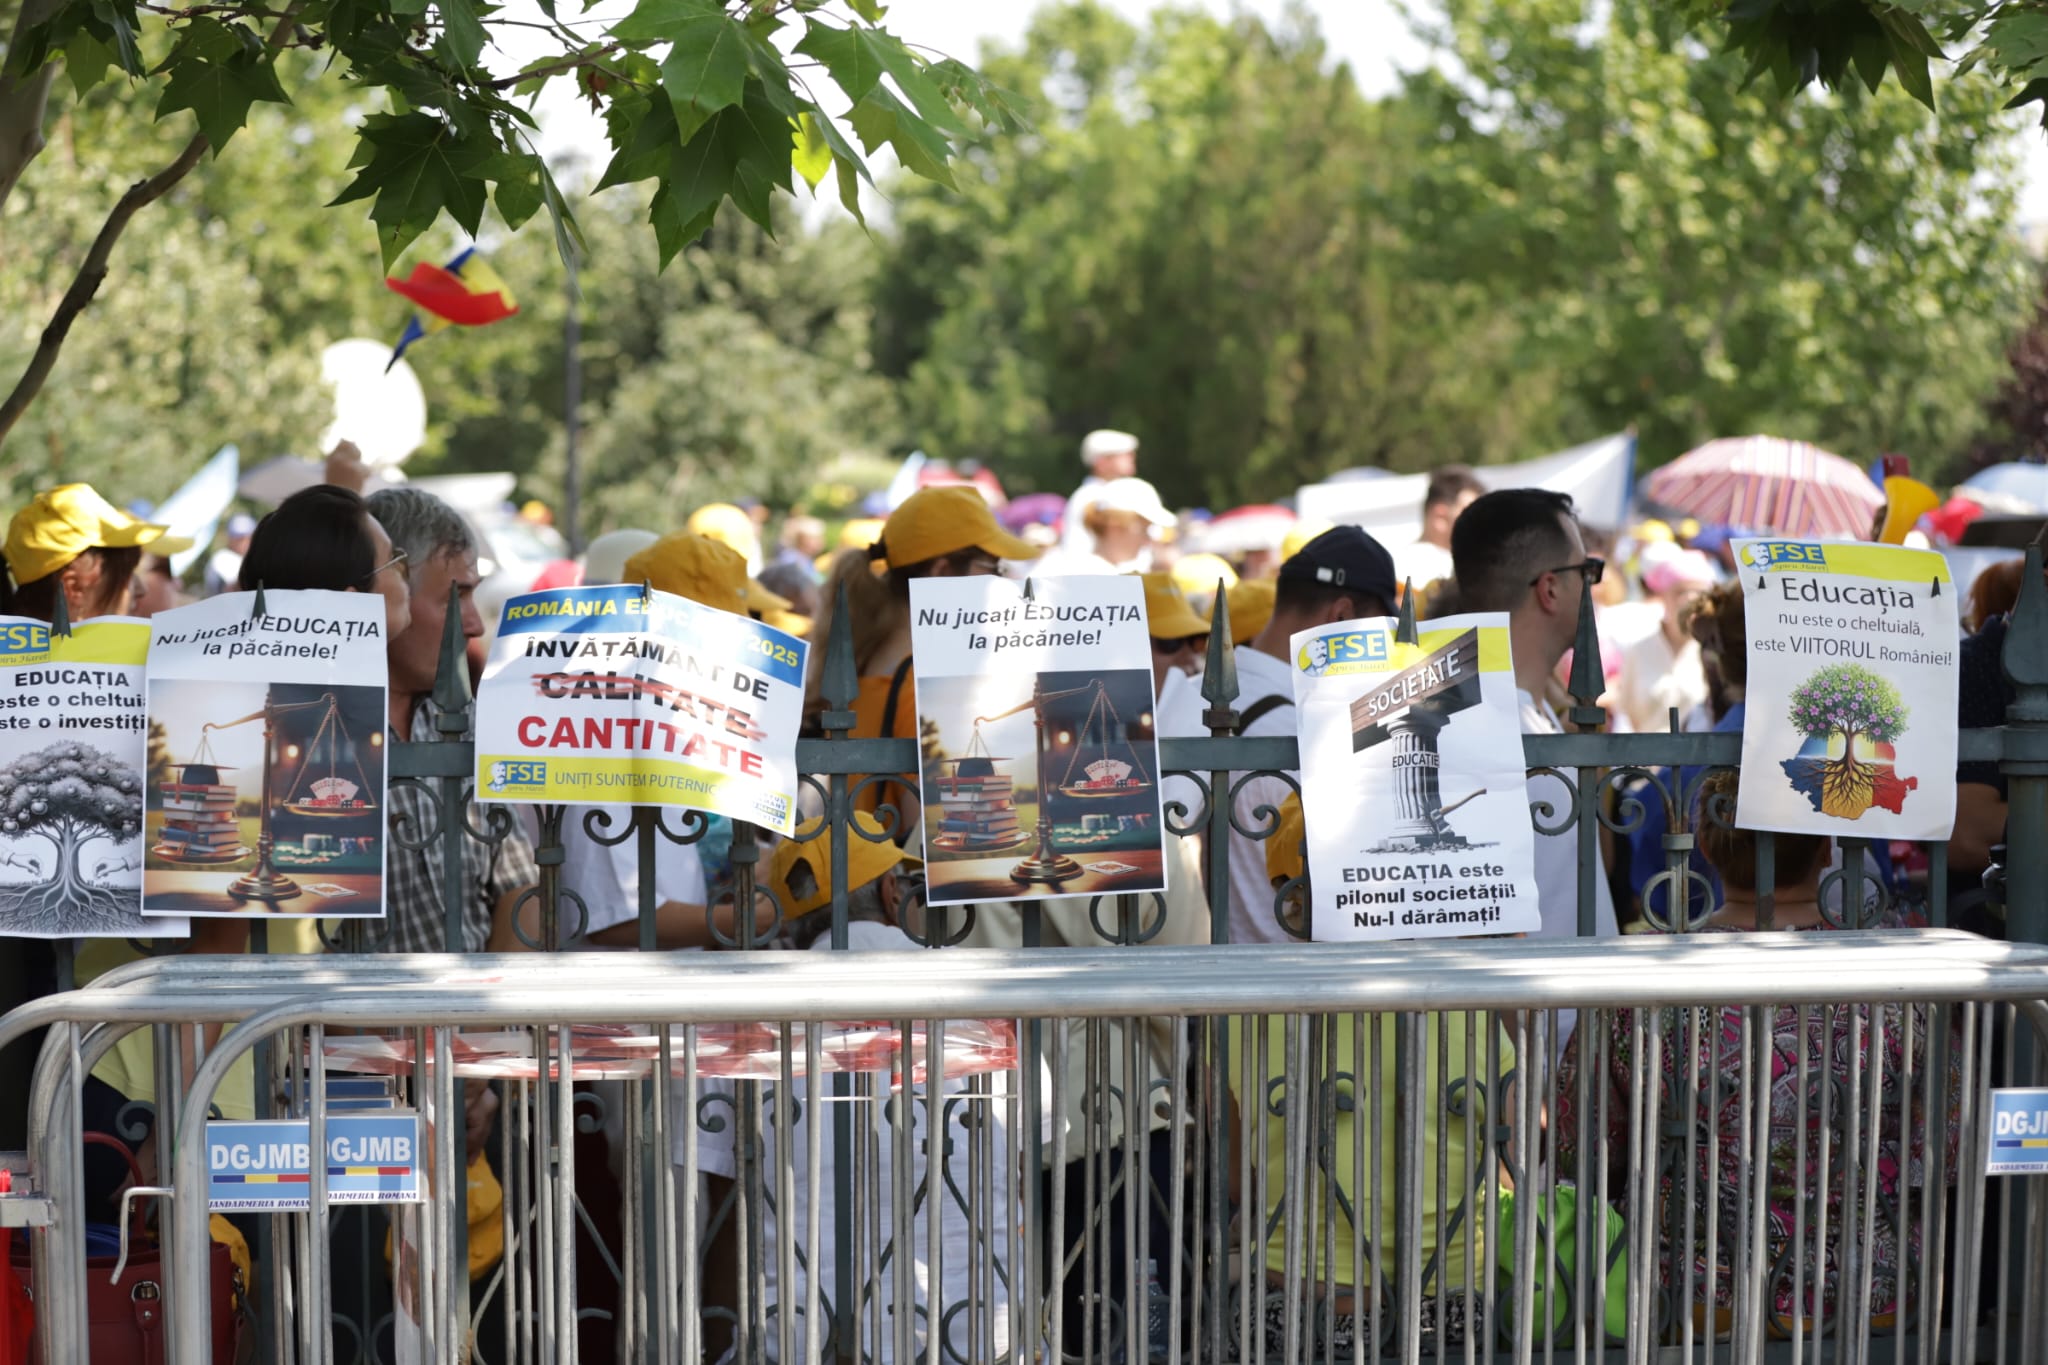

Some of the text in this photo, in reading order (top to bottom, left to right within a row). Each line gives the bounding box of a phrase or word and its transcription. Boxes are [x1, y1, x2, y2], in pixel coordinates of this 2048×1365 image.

[1768, 543, 1823, 561] FSE
[1782, 577, 1915, 615] Educația
[918, 604, 1141, 629] Nu jucați EDUCAȚIA
[1778, 613, 1925, 638] nu este o cheltuială,
[157, 615, 380, 646] Nu jucați EDUCAȚIA
[507, 598, 618, 621] ROMÂNIA
[750, 636, 799, 668] 2025
[968, 629, 1101, 652] la păcănele!
[203, 639, 338, 659] la păcănele!
[1328, 633, 1385, 659] FSE
[1754, 636, 1953, 666] este VIITORUL României!
[15, 670, 129, 690] EDUCAȚIA
[733, 672, 770, 701] DE
[1368, 648, 1461, 717] SOCIETATE
[47, 697, 60, 706] o
[68, 692, 146, 707] cheltui
[540, 671, 752, 739] CALITATE
[38, 717, 51, 729] o
[517, 716, 764, 779] CANTITATE
[506, 764, 545, 781] FSE
[1392, 754, 1439, 768] EDUCATIE
[555, 772, 592, 788] UNIȚI
[596, 773, 646, 787] SUNTEM
[1342, 863, 1504, 884] EDUCAȚIA este
[1336, 884, 1516, 909] pilonul societății!
[1354, 906, 1501, 927] Nu-l dărâmați!
[211, 1144, 310, 1170] DGJMB
[326, 1137, 412, 1162] GJMB
